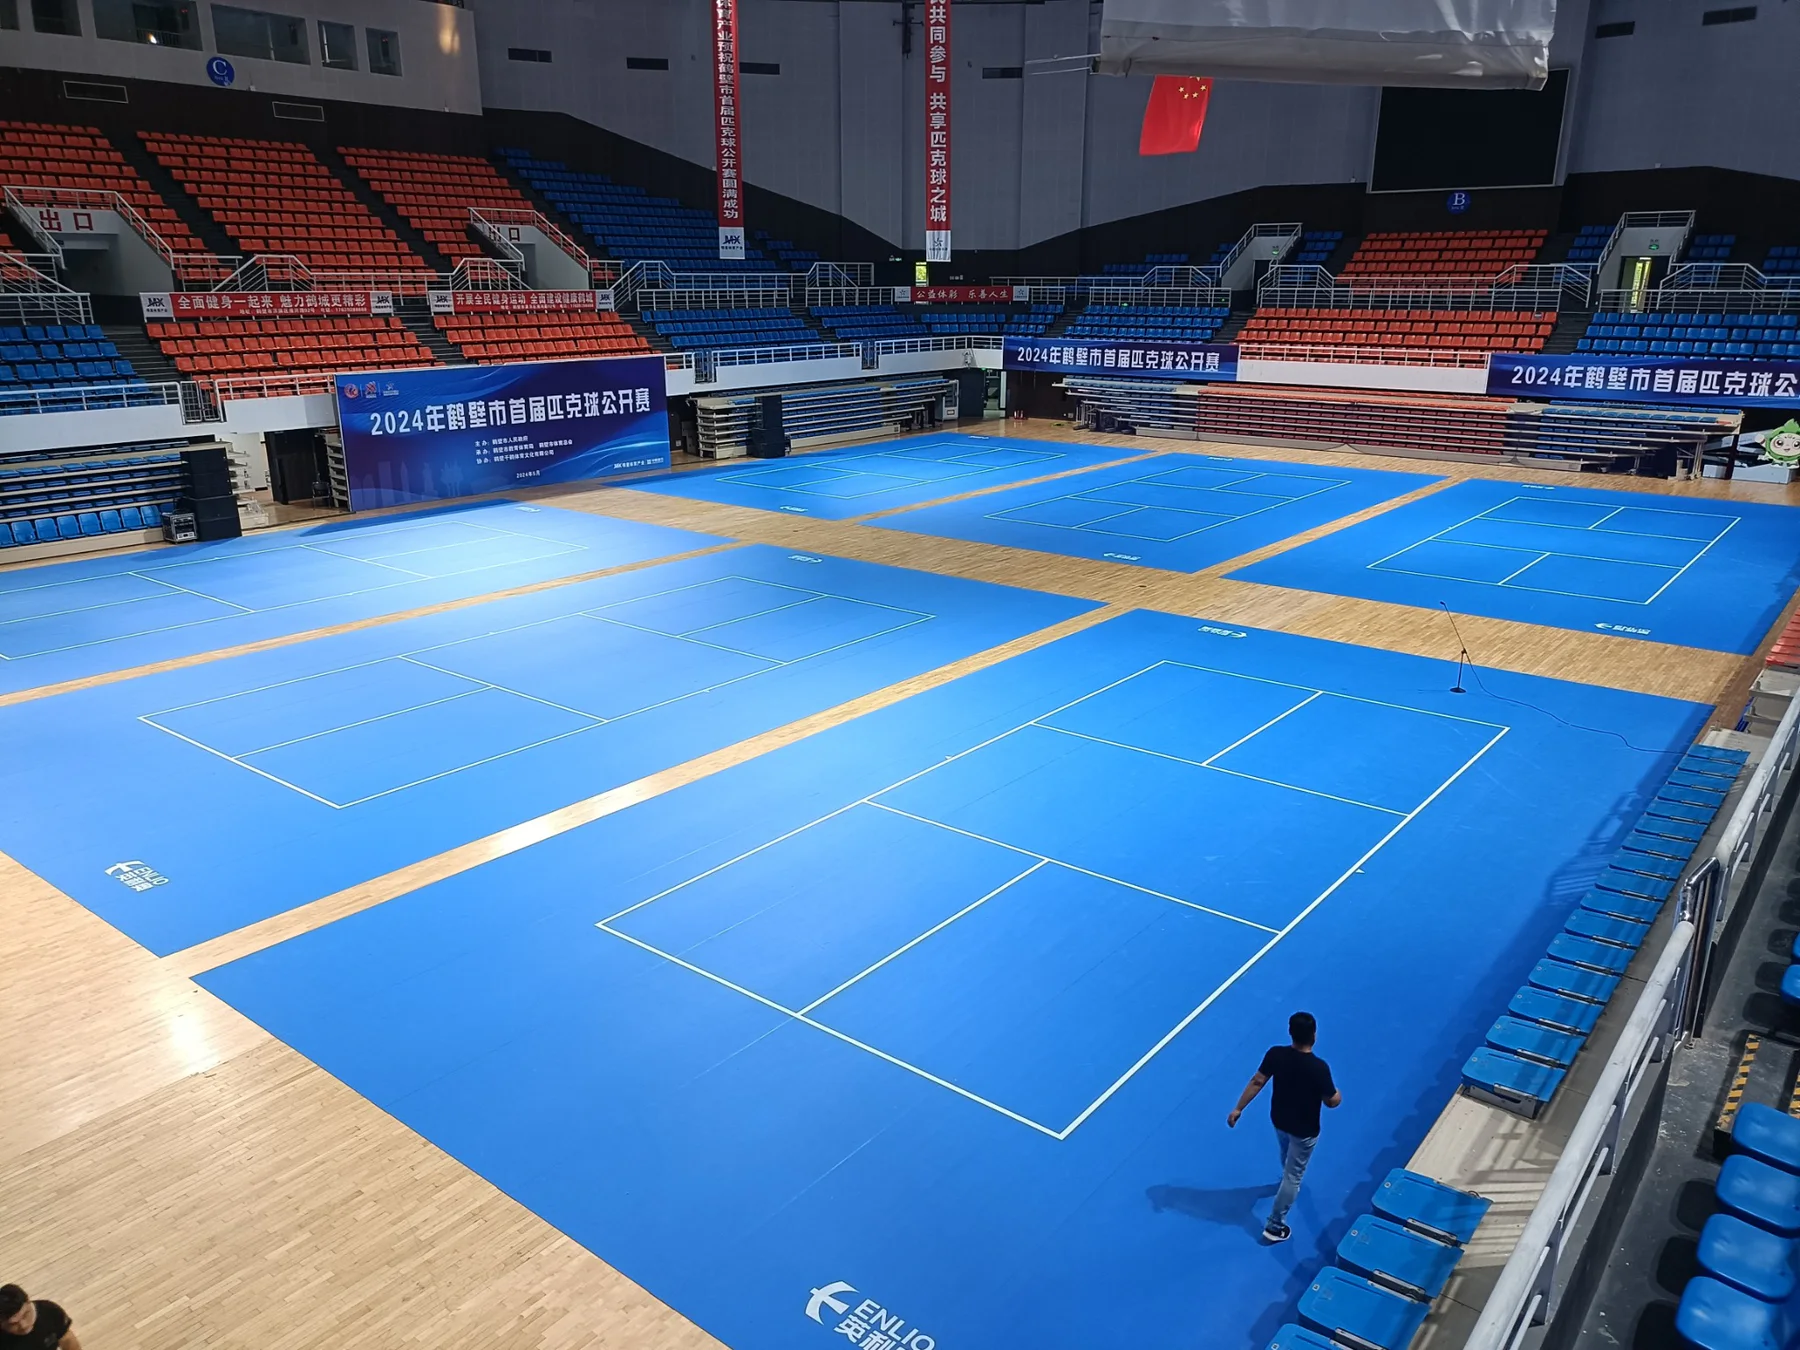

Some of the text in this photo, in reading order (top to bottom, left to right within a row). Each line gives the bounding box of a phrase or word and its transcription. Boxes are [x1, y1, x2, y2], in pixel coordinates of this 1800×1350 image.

[212, 59, 228, 76] C
[929, 0, 947, 222] 共同参与 共享匹克球之城
[1452, 192, 1466, 206] B
[39, 208, 94, 232] 出口
[178, 293, 366, 310] 全面健身一起来 魅力鹤城更精彩
[456, 292, 526, 306] 开展全民健身运动
[968, 289, 1009, 299] 乐善人生
[1017, 346, 1220, 372] 2024年鹤壁市首届匹克球公开赛
[370, 387, 651, 436] 2024年鹤壁市首届匹克球公开赛
[854, 1298, 935, 1350] ENLIO
